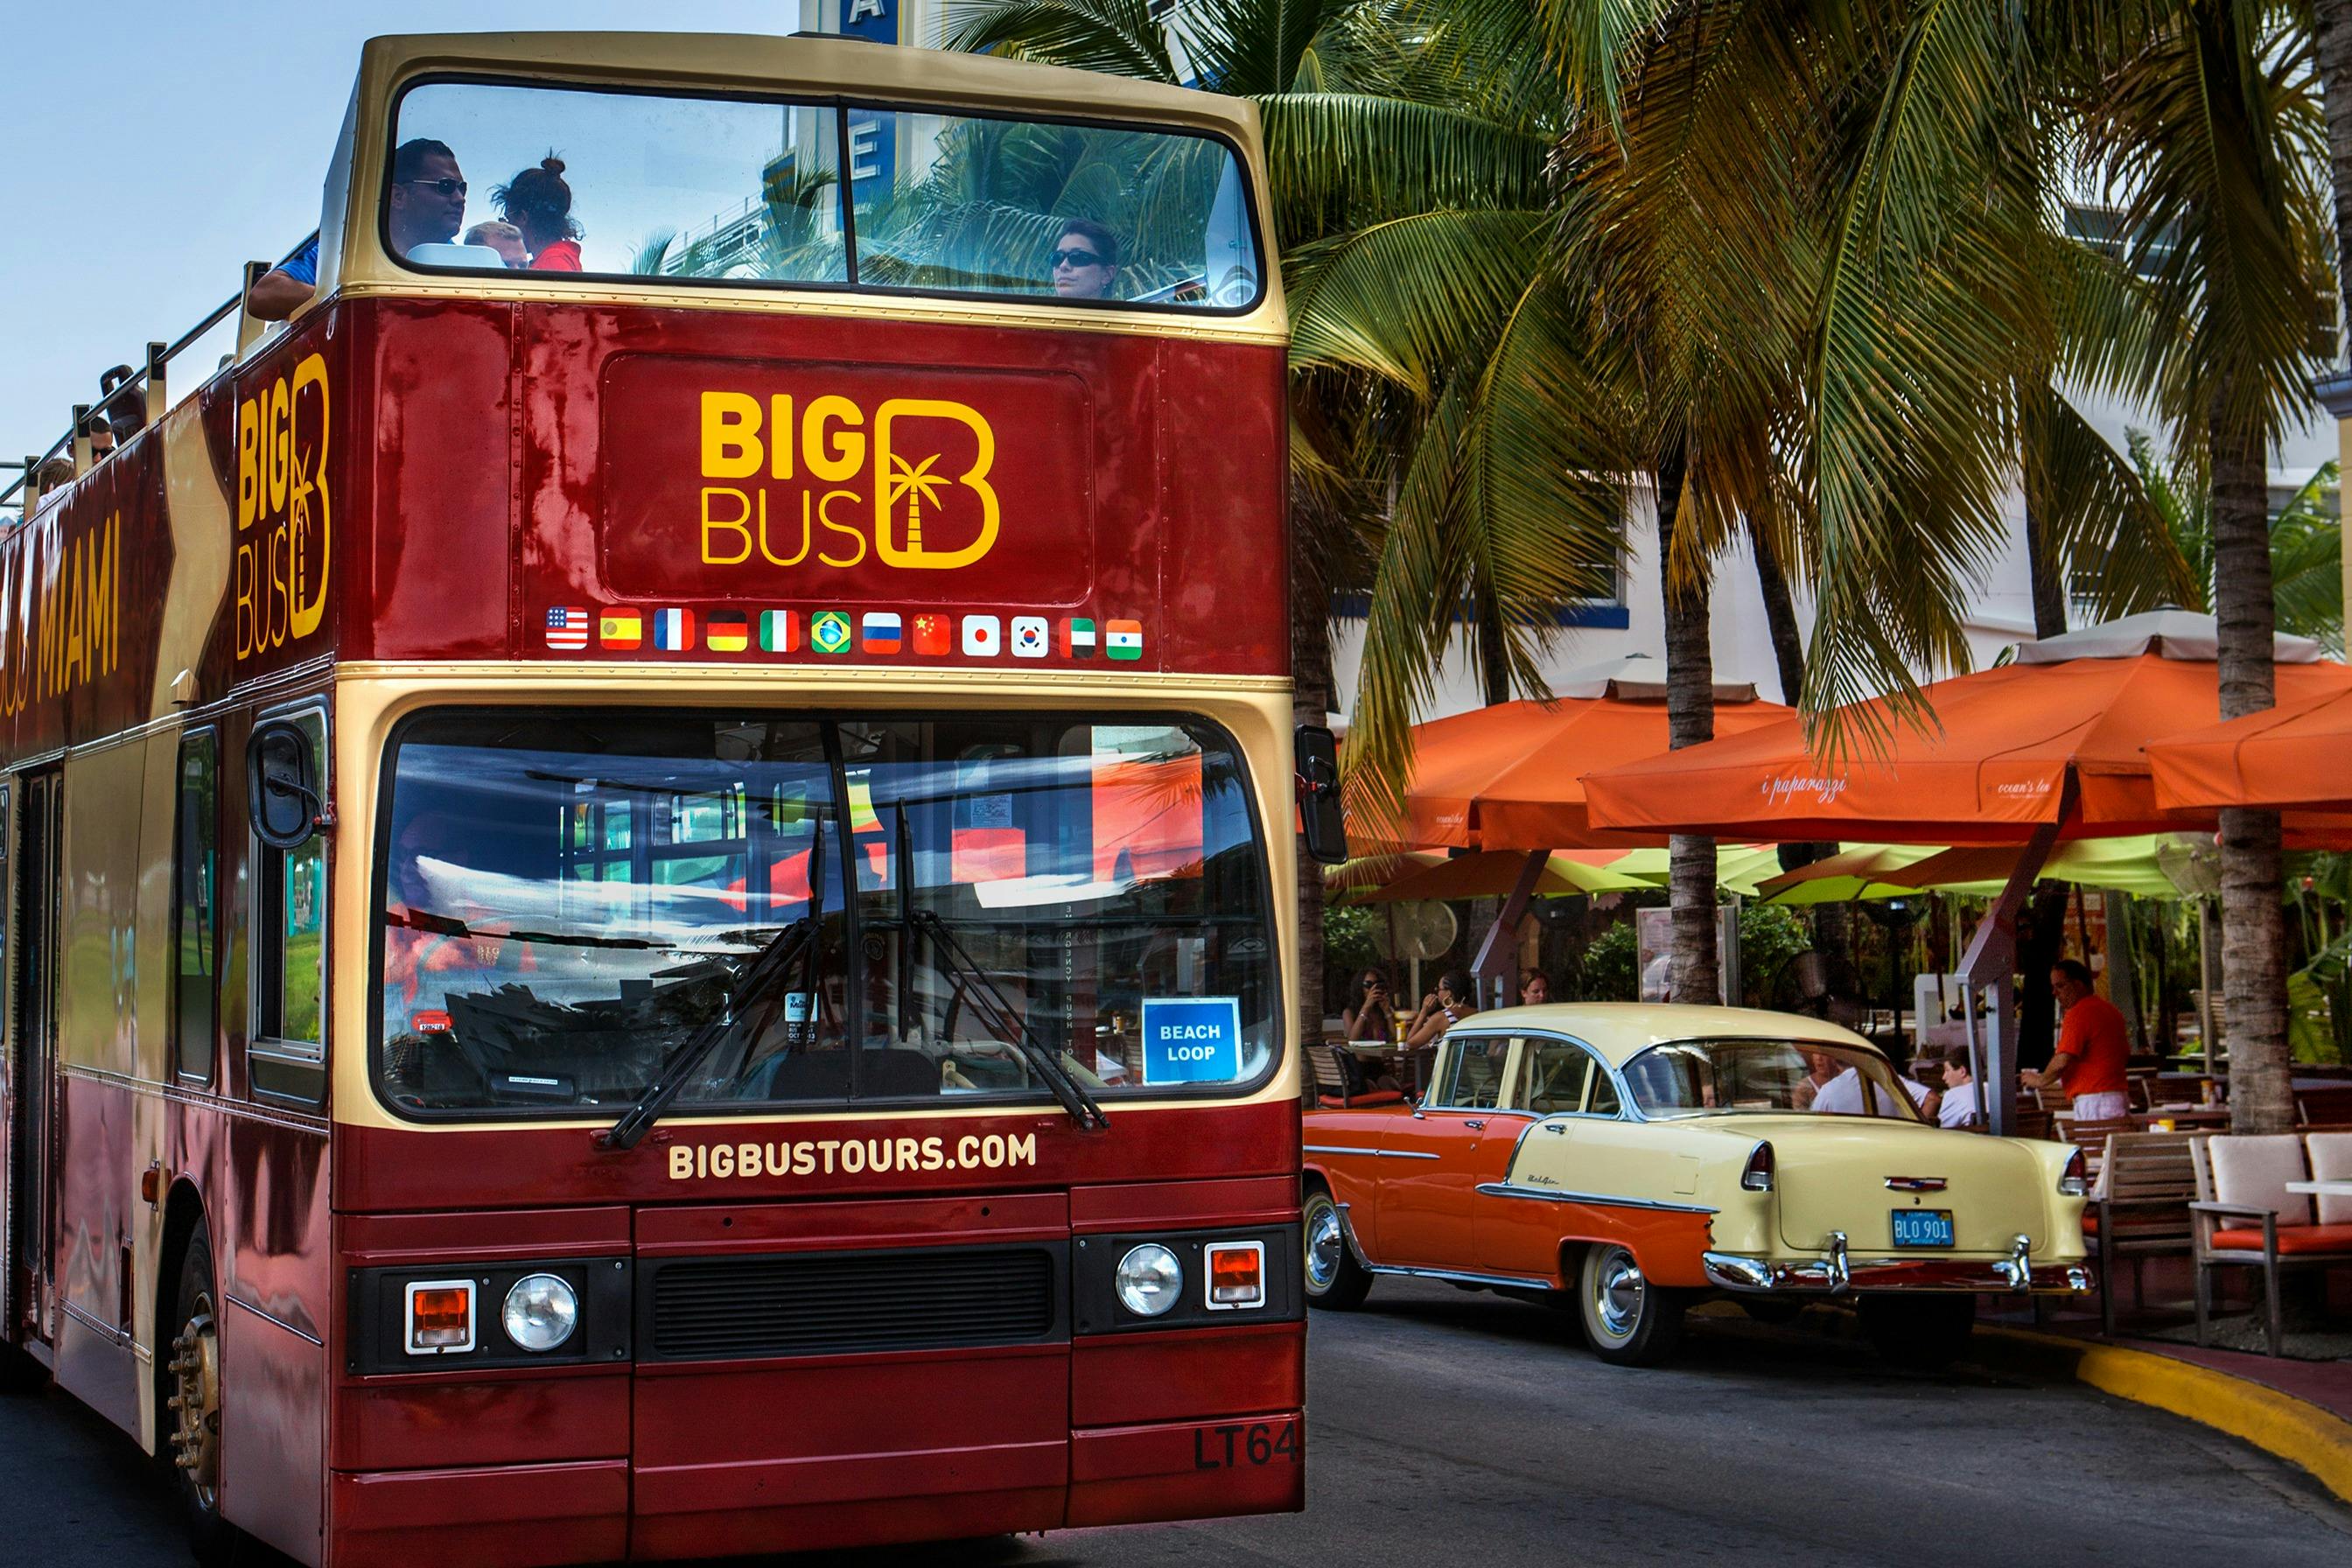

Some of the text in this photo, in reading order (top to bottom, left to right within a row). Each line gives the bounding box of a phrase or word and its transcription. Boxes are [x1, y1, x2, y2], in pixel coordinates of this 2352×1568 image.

[239, 377, 289, 531] BIG
[701, 391, 865, 481] BIG
[701, 486, 866, 567] BUS
[36, 508, 120, 704] MIAMI
[237, 526, 287, 661] BUS
[1769, 772, 1846, 805] paparazzi
[1160, 1025, 1221, 1040] BEACH
[1167, 1046, 1215, 1060] LOOP
[668, 1133, 1036, 1180] BIGBUSTOURS.COM
[1923, 1221, 1949, 1239] 901
[1194, 1421, 1296, 1469] LT64
